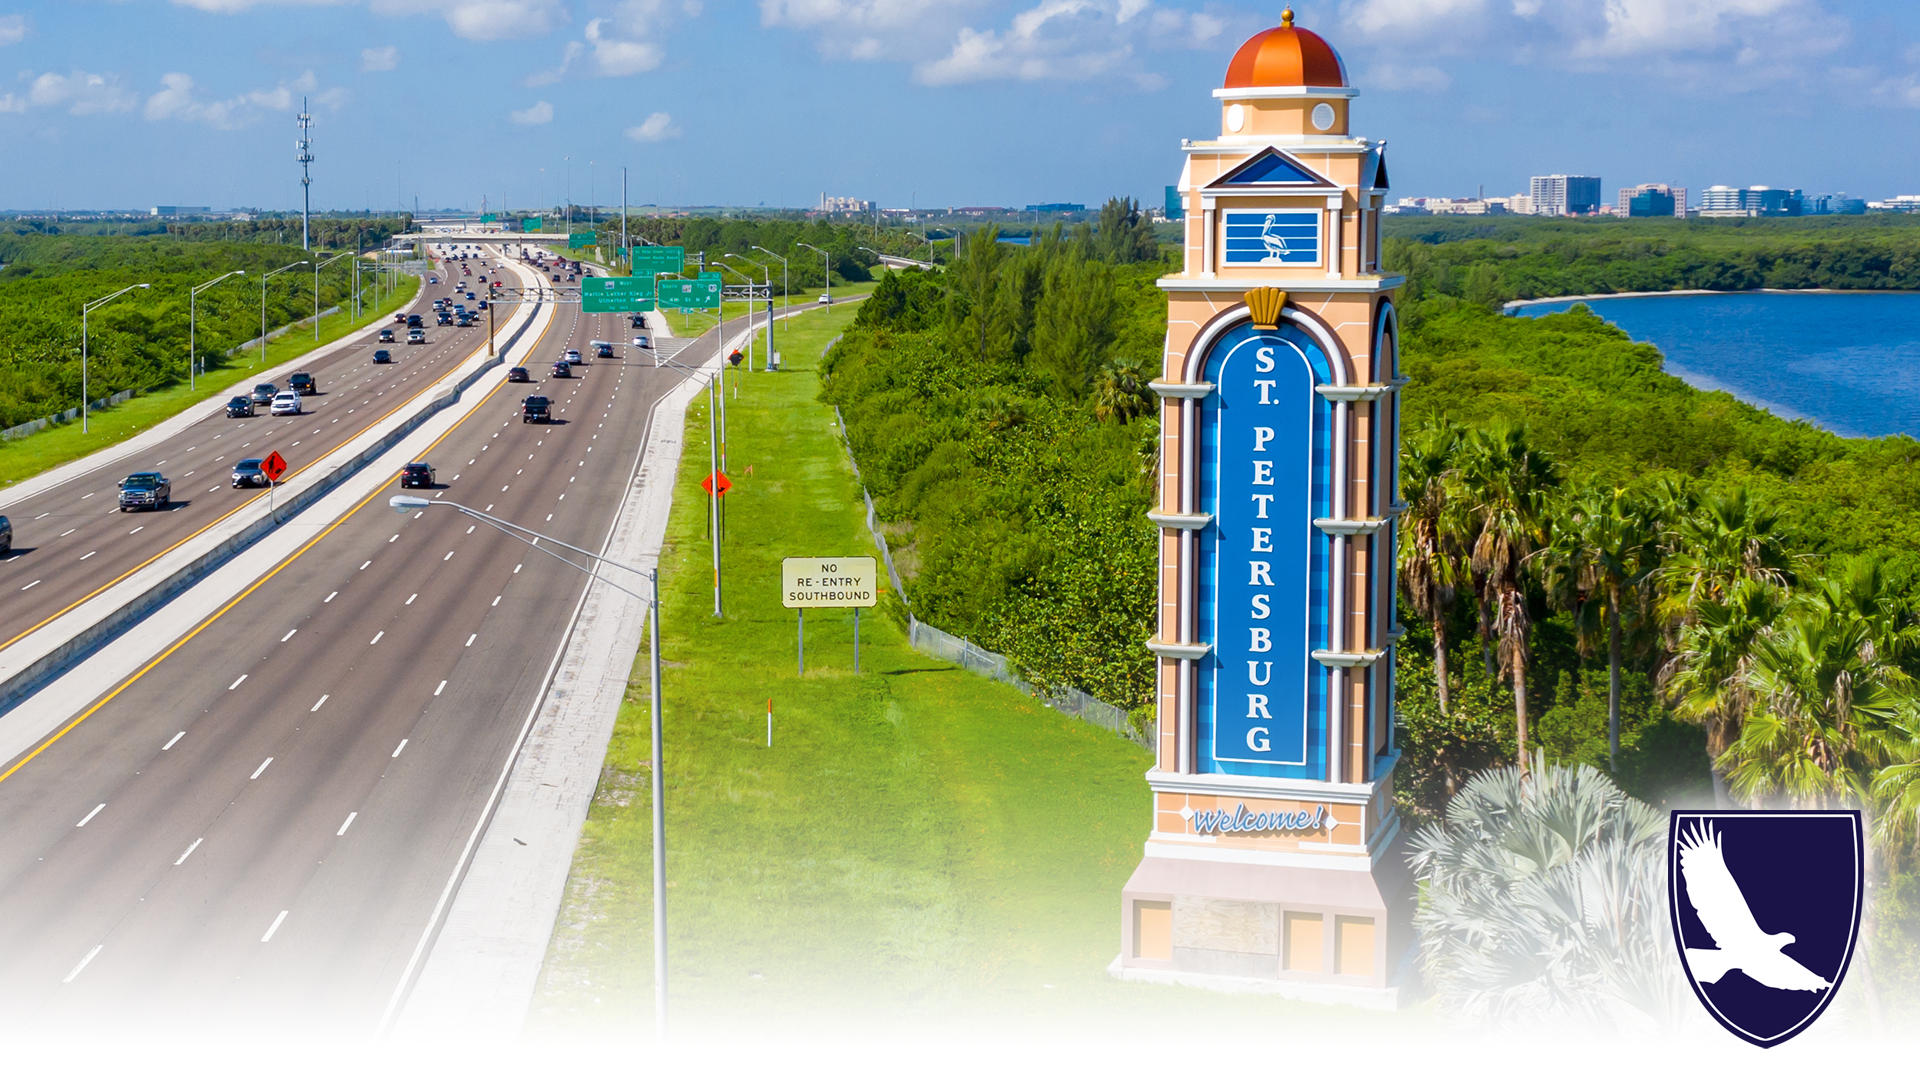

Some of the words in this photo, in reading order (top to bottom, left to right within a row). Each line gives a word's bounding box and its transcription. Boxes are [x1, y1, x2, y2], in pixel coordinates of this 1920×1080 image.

[1255, 347, 1279, 406] ST.
[821, 564, 837, 573] NO
[789, 591, 870, 601] SOUTHBOUND
[1245, 425, 1276, 753] PETERSBURG
[1194, 802, 1324, 833] Welcome!
